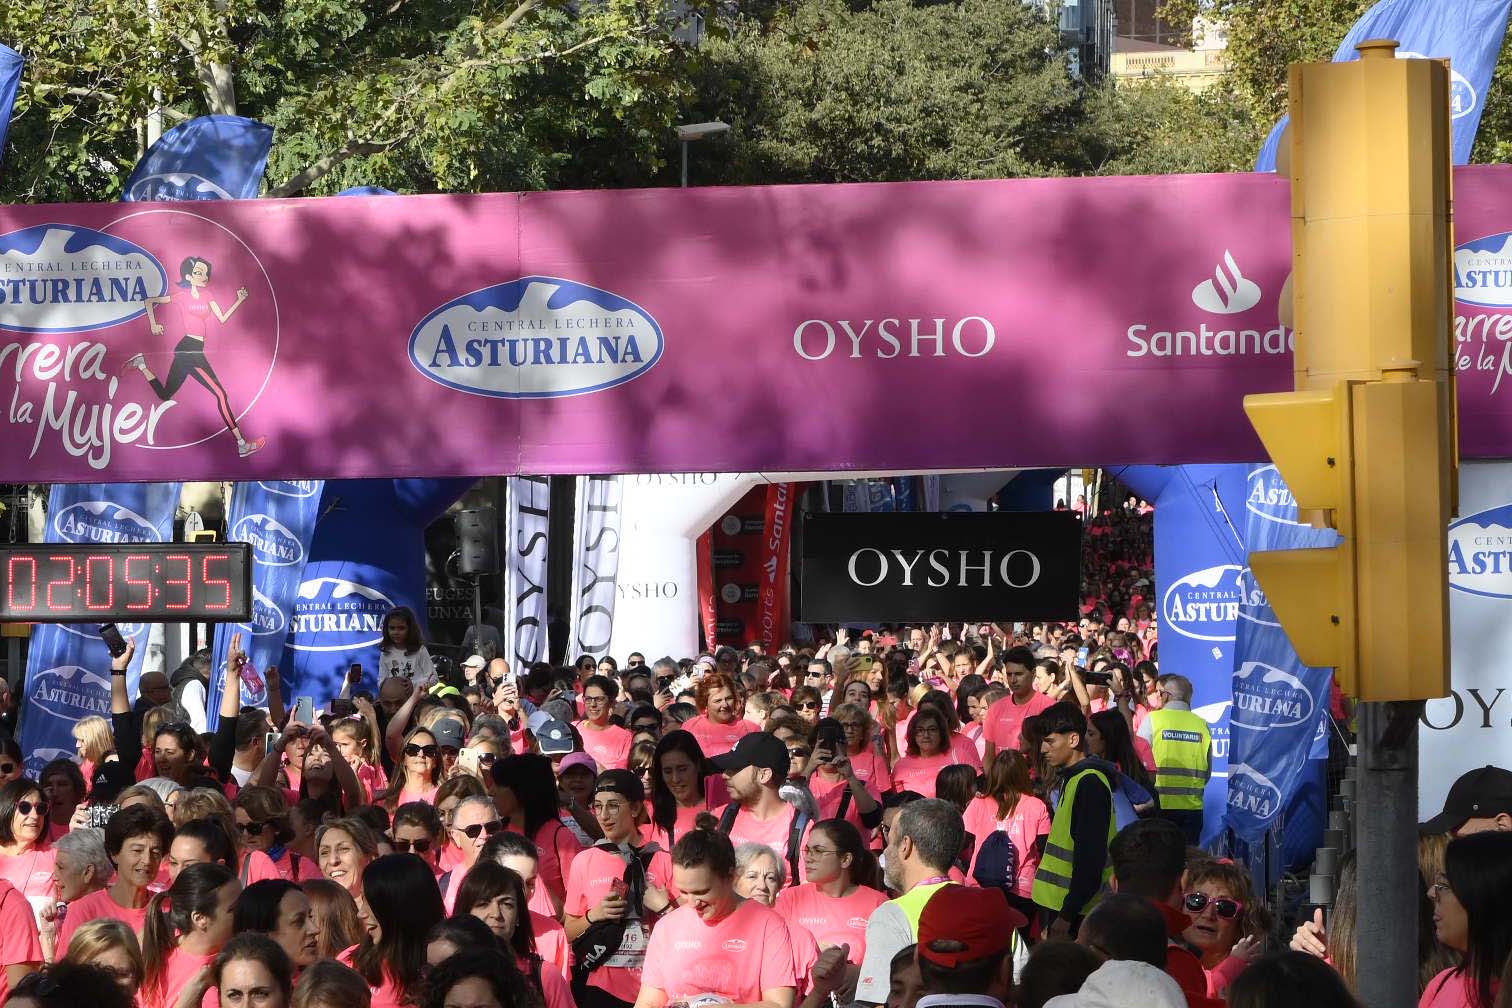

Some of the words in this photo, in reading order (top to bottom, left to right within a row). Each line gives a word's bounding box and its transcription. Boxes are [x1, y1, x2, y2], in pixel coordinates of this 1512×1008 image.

[71, 260, 144, 272] LECHERA
[428, 324, 644, 368] ASTURIANA
[468, 318, 547, 333] CENTRAL
[554, 316, 636, 331] LECHERA
[793, 315, 996, 361] OYSHO
[9, 383, 34, 424] la
[29, 377, 178, 470] Mujer
[8, 555, 231, 611] 02:05:35
[847, 547, 1041, 589] OYSHO
[1187, 591, 1238, 600] CENTRAL
